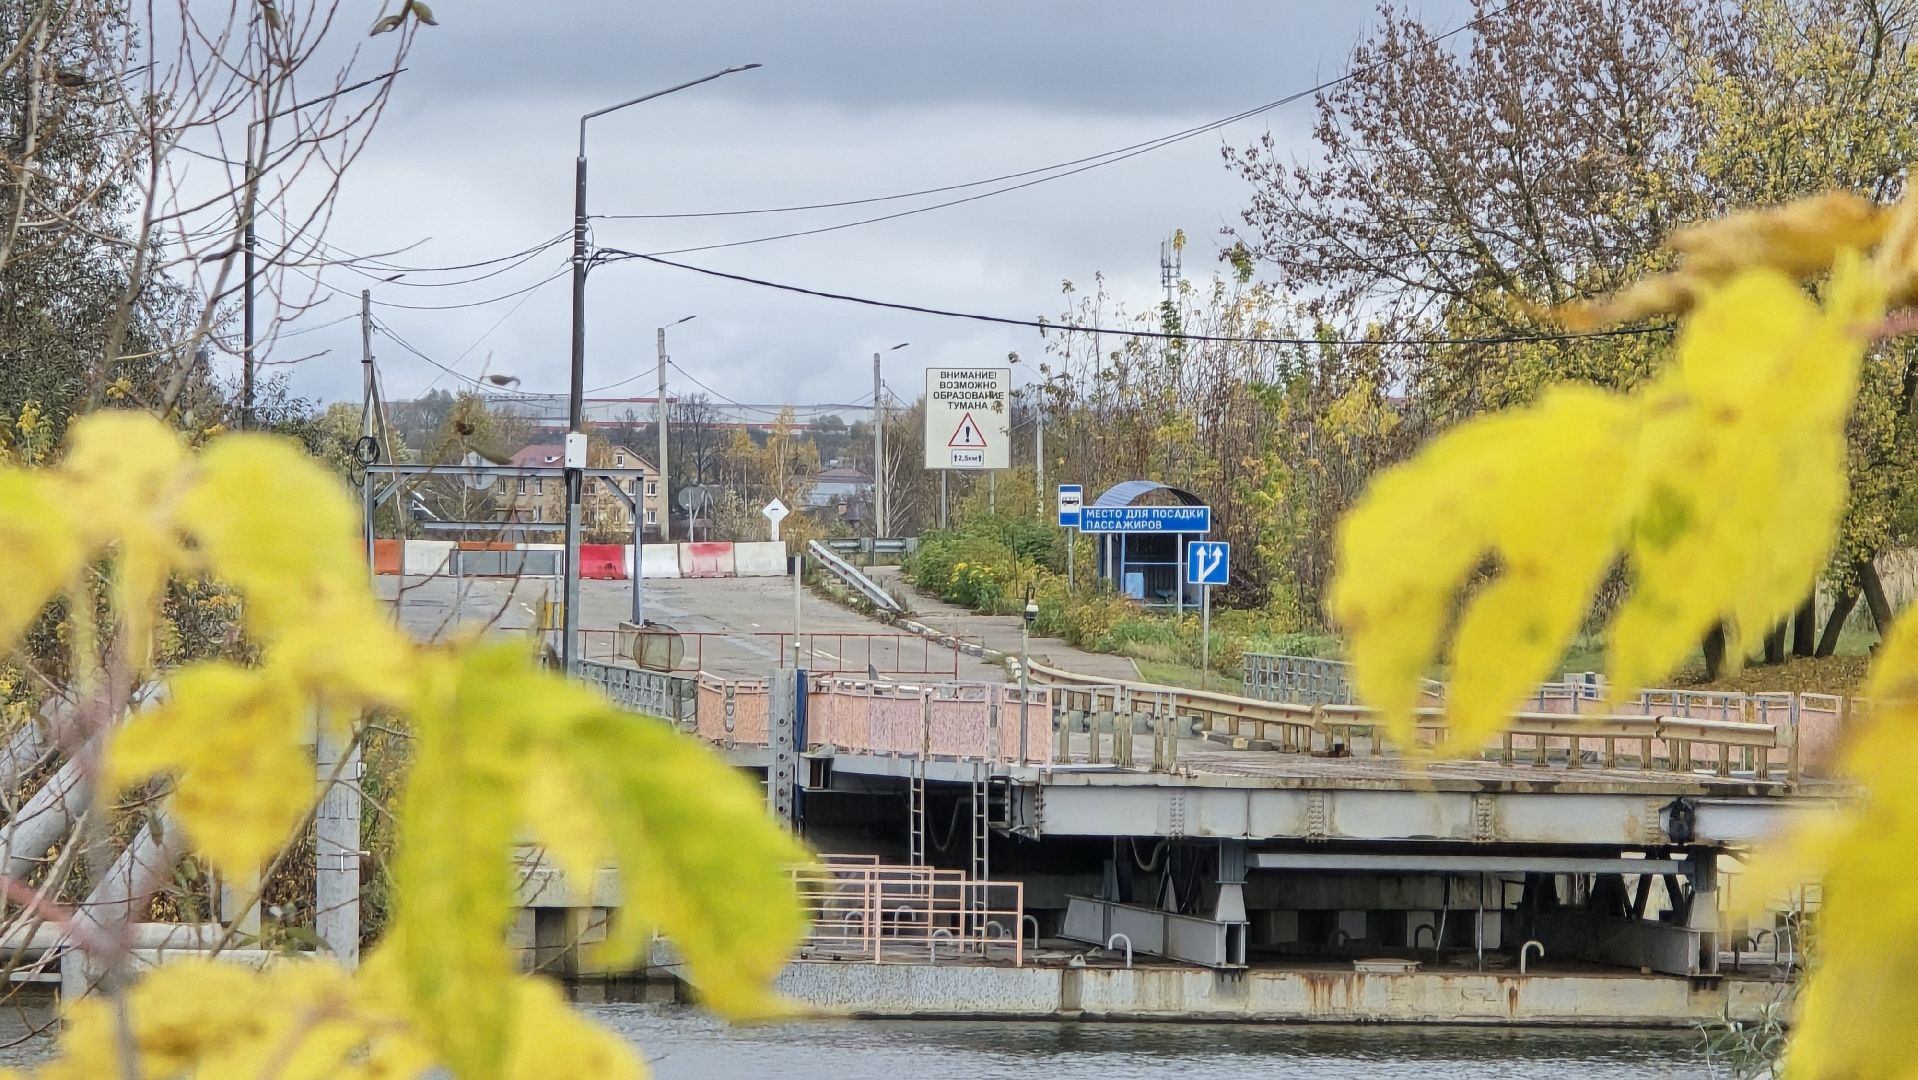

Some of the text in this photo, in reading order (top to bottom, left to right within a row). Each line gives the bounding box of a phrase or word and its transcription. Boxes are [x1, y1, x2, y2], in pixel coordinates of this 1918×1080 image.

[940, 371, 997, 380] ВНИМАНИЕ!
[939, 382, 997, 390] ВОЗМОЖНО
[933, 392, 1004, 400] ОБРАЗОВАНИЕ
[948, 402, 988, 410] ТУМАНА
[1086, 510, 1204, 520] МЕСТО ДЛЯ ПОСАДКИ
[1086, 520, 1162, 530] ПАССАЖИРОВ
